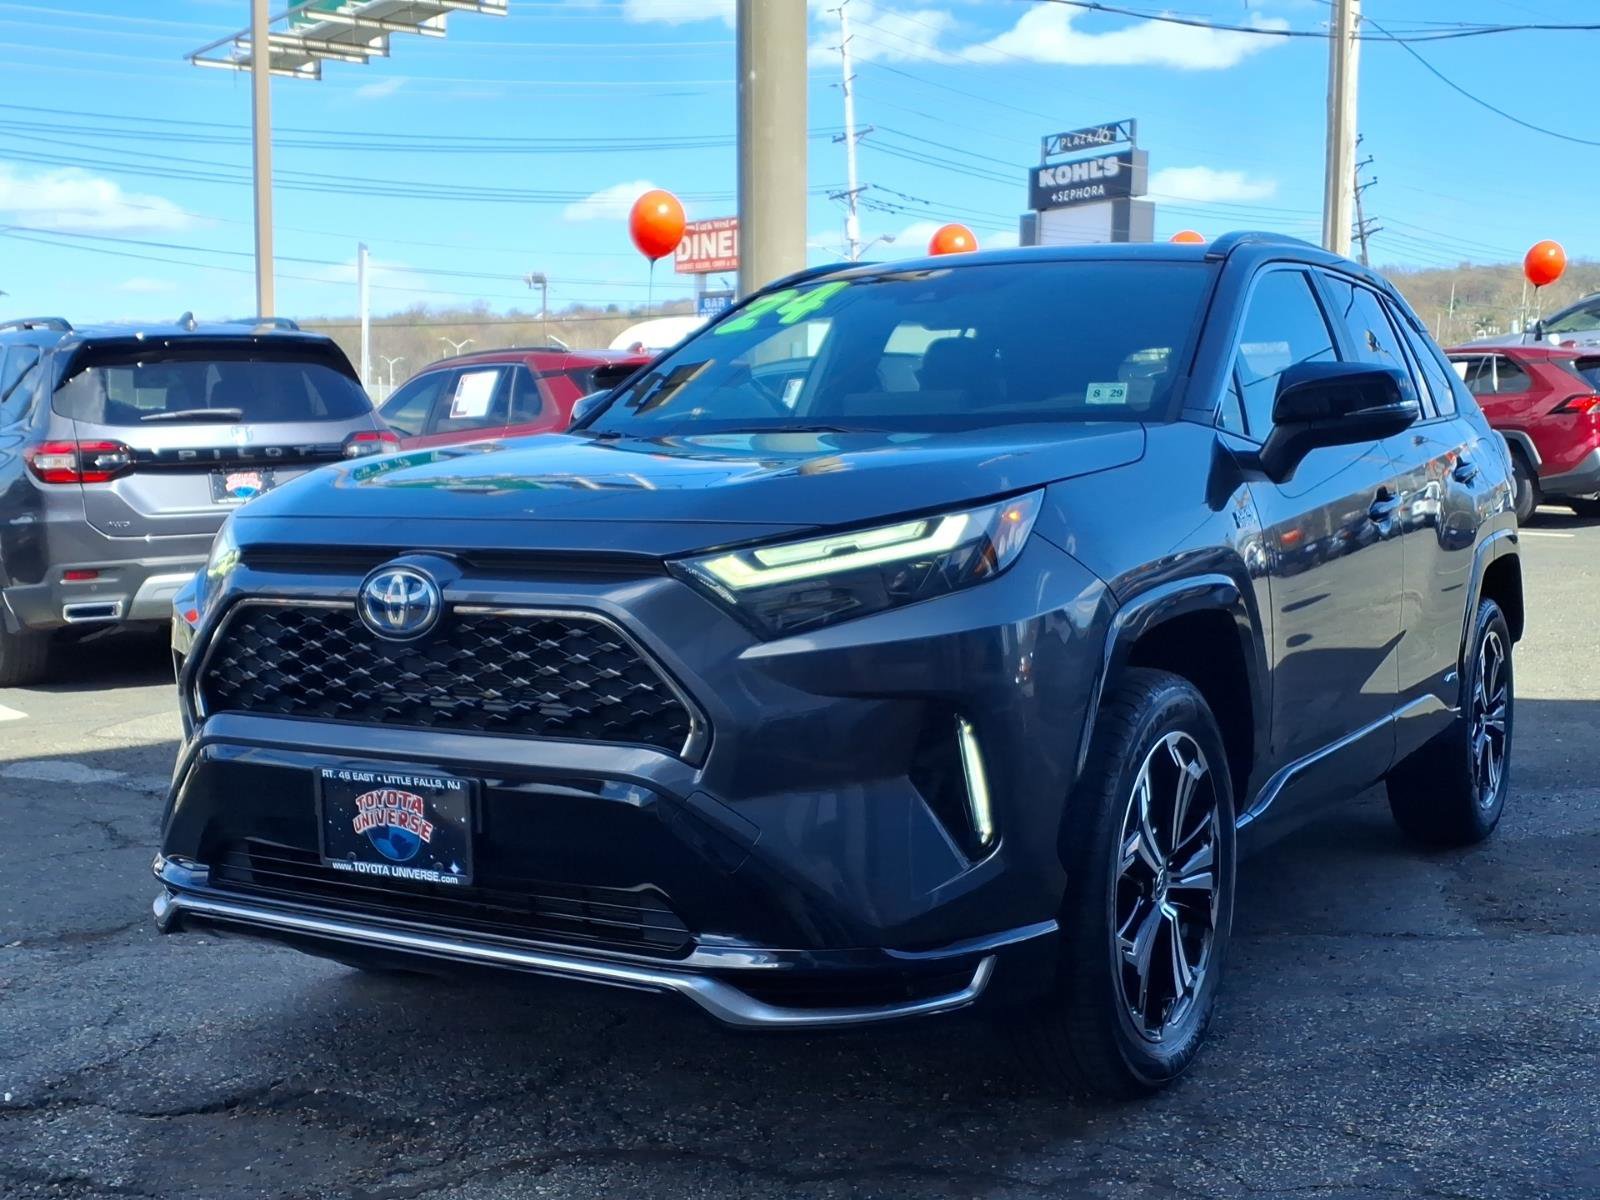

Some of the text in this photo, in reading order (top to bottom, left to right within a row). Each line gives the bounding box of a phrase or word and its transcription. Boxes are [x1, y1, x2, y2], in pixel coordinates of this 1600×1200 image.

[1061, 134, 1094, 147] PLAZA
[1039, 156, 1119, 187] KOHL'S
[1093, 389, 1123, 398] 8 29
[178, 445, 316, 461] PILOT
[322, 768, 336, 779] RT.
[352, 772, 374, 783] EAST
[383, 775, 412, 786] LITTLE
[447, 780, 460, 790] NJ
[355, 789, 424, 817] TOYOTA
[352, 808, 434, 844] UNIVERSE
